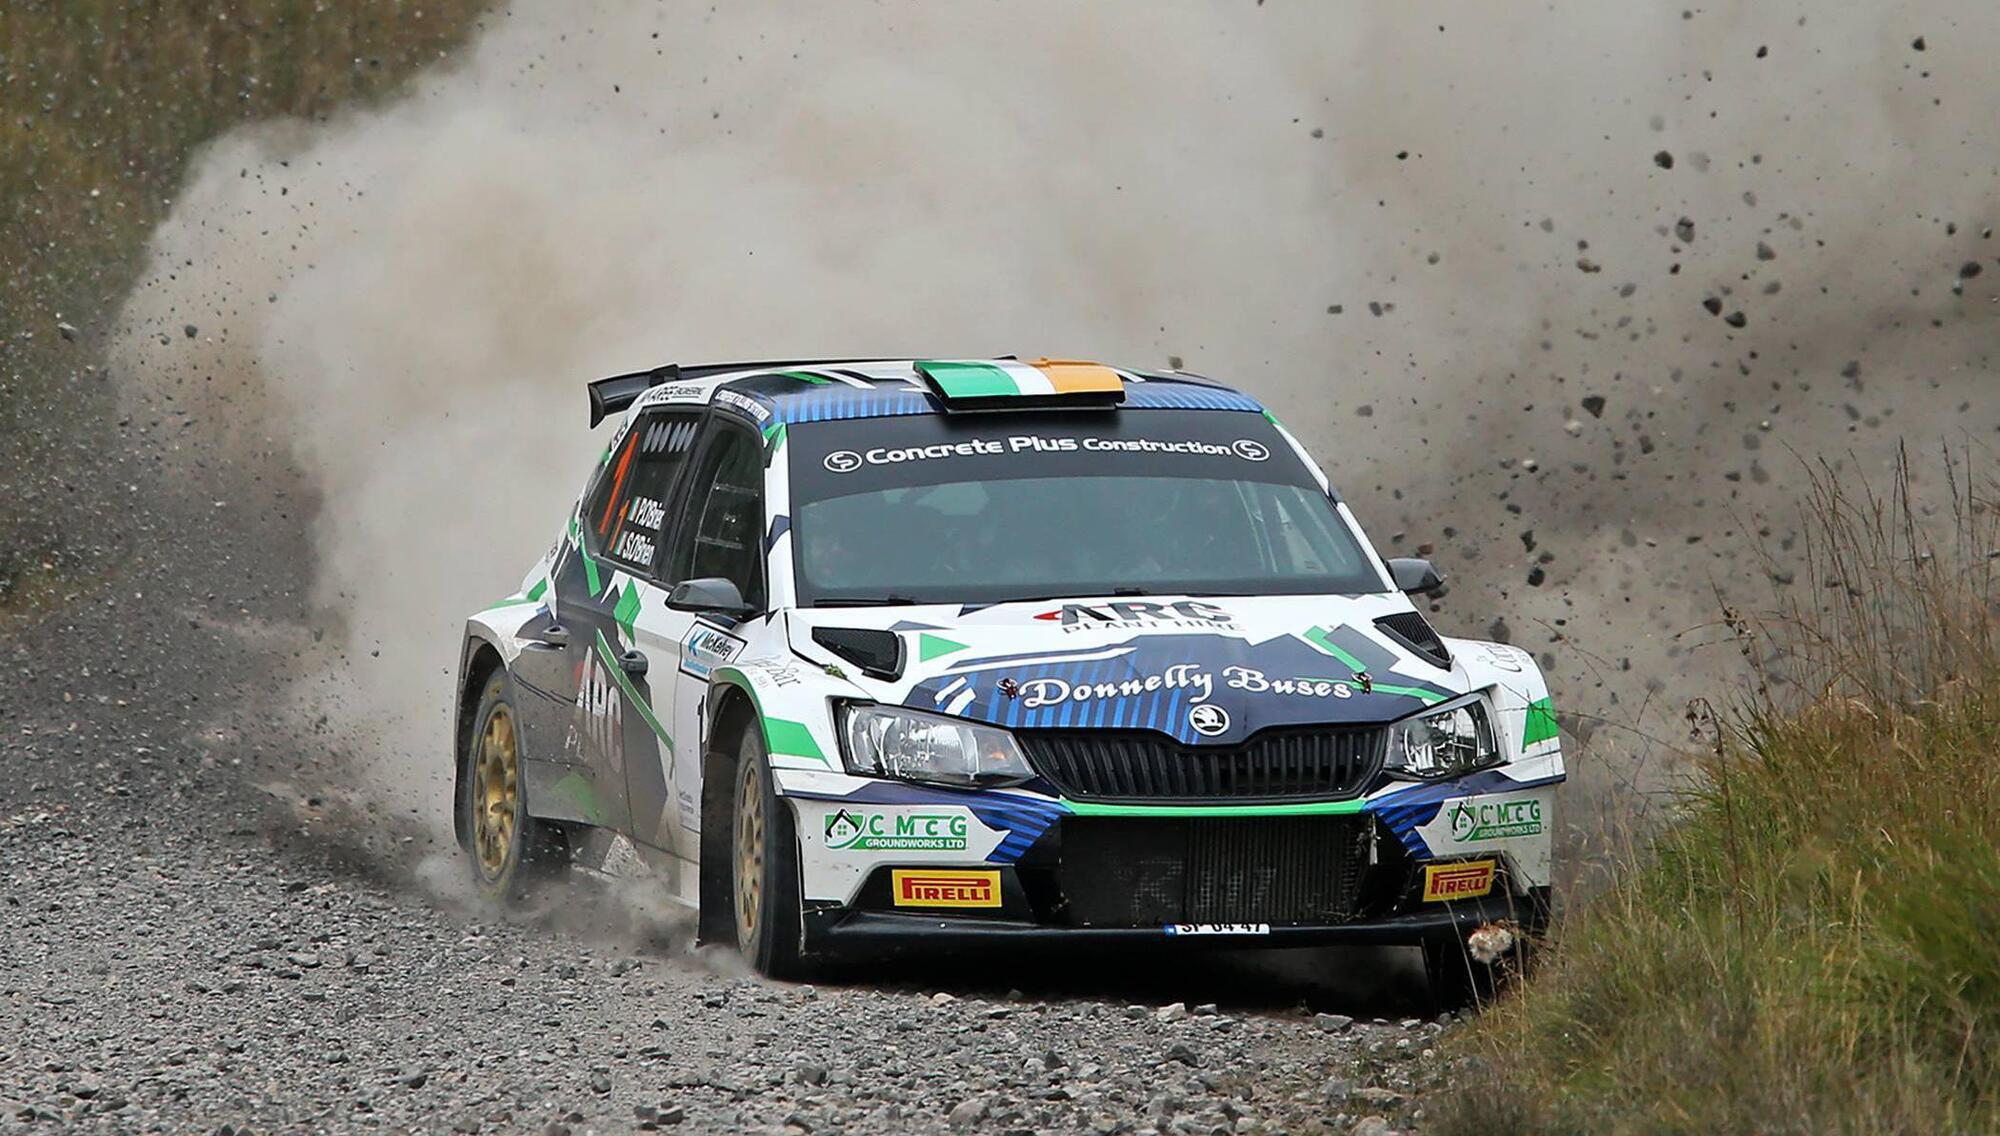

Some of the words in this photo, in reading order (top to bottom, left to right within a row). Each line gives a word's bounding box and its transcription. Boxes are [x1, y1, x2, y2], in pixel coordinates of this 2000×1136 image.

[866, 438, 1004, 464] Concrete
[1008, 436, 1078, 452] Plus
[1083, 438, 1232, 456] Construction
[1063, 620, 1159, 634] PLANT
[1174, 619, 1247, 631] HIRE
[1019, 664, 1213, 708] Donnelly
[1222, 666, 1353, 699] Buses
[865, 838, 944, 849] GROUNDWORKS
[946, 838, 965, 849] LTD
[901, 877, 992, 901] PIRELLI
[1430, 867, 1490, 895] PIRELLI
